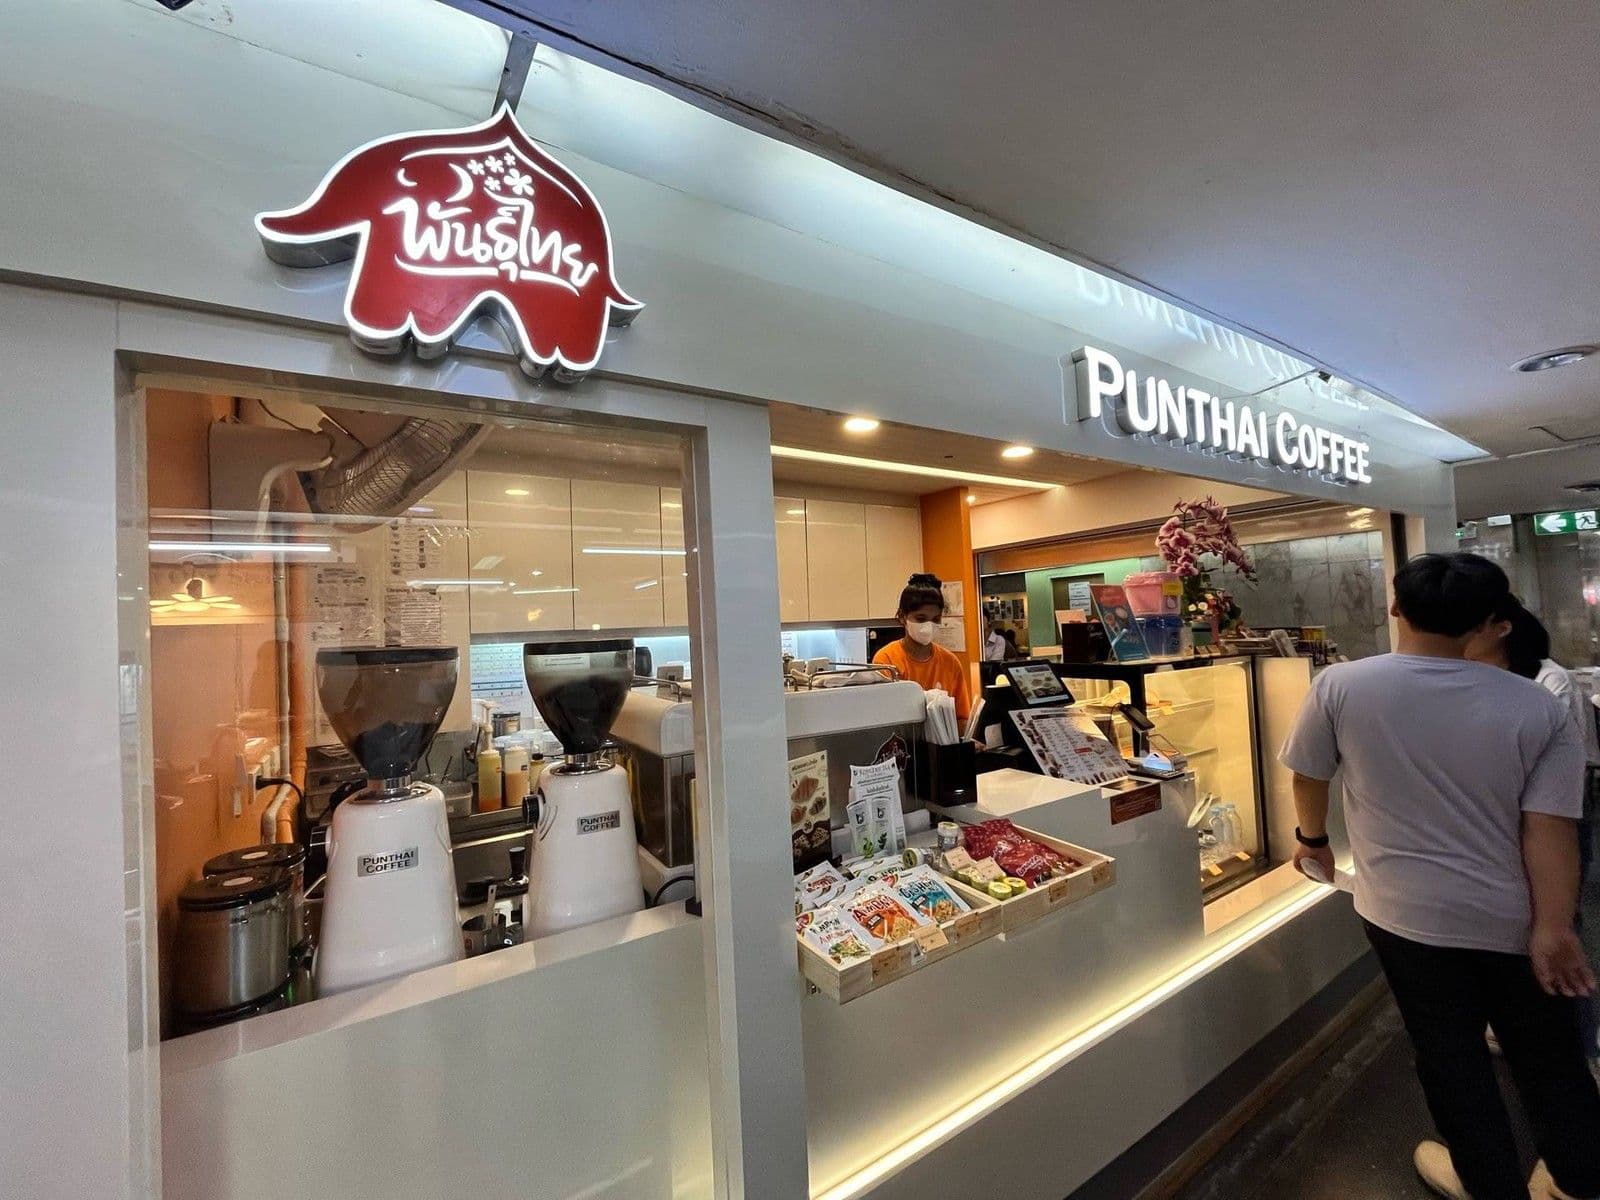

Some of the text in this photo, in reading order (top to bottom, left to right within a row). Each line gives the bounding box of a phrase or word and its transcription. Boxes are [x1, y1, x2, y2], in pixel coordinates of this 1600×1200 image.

[383, 187, 599, 287] พันธุ์ไทย
[1084, 345, 1372, 484] PUNTHAI COFFEE
[580, 813, 618, 826] PUNTHAI
[583, 820, 616, 832] COFFEE
[362, 850, 414, 866] PUNTHAI
[366, 859, 411, 873] COFFEE
